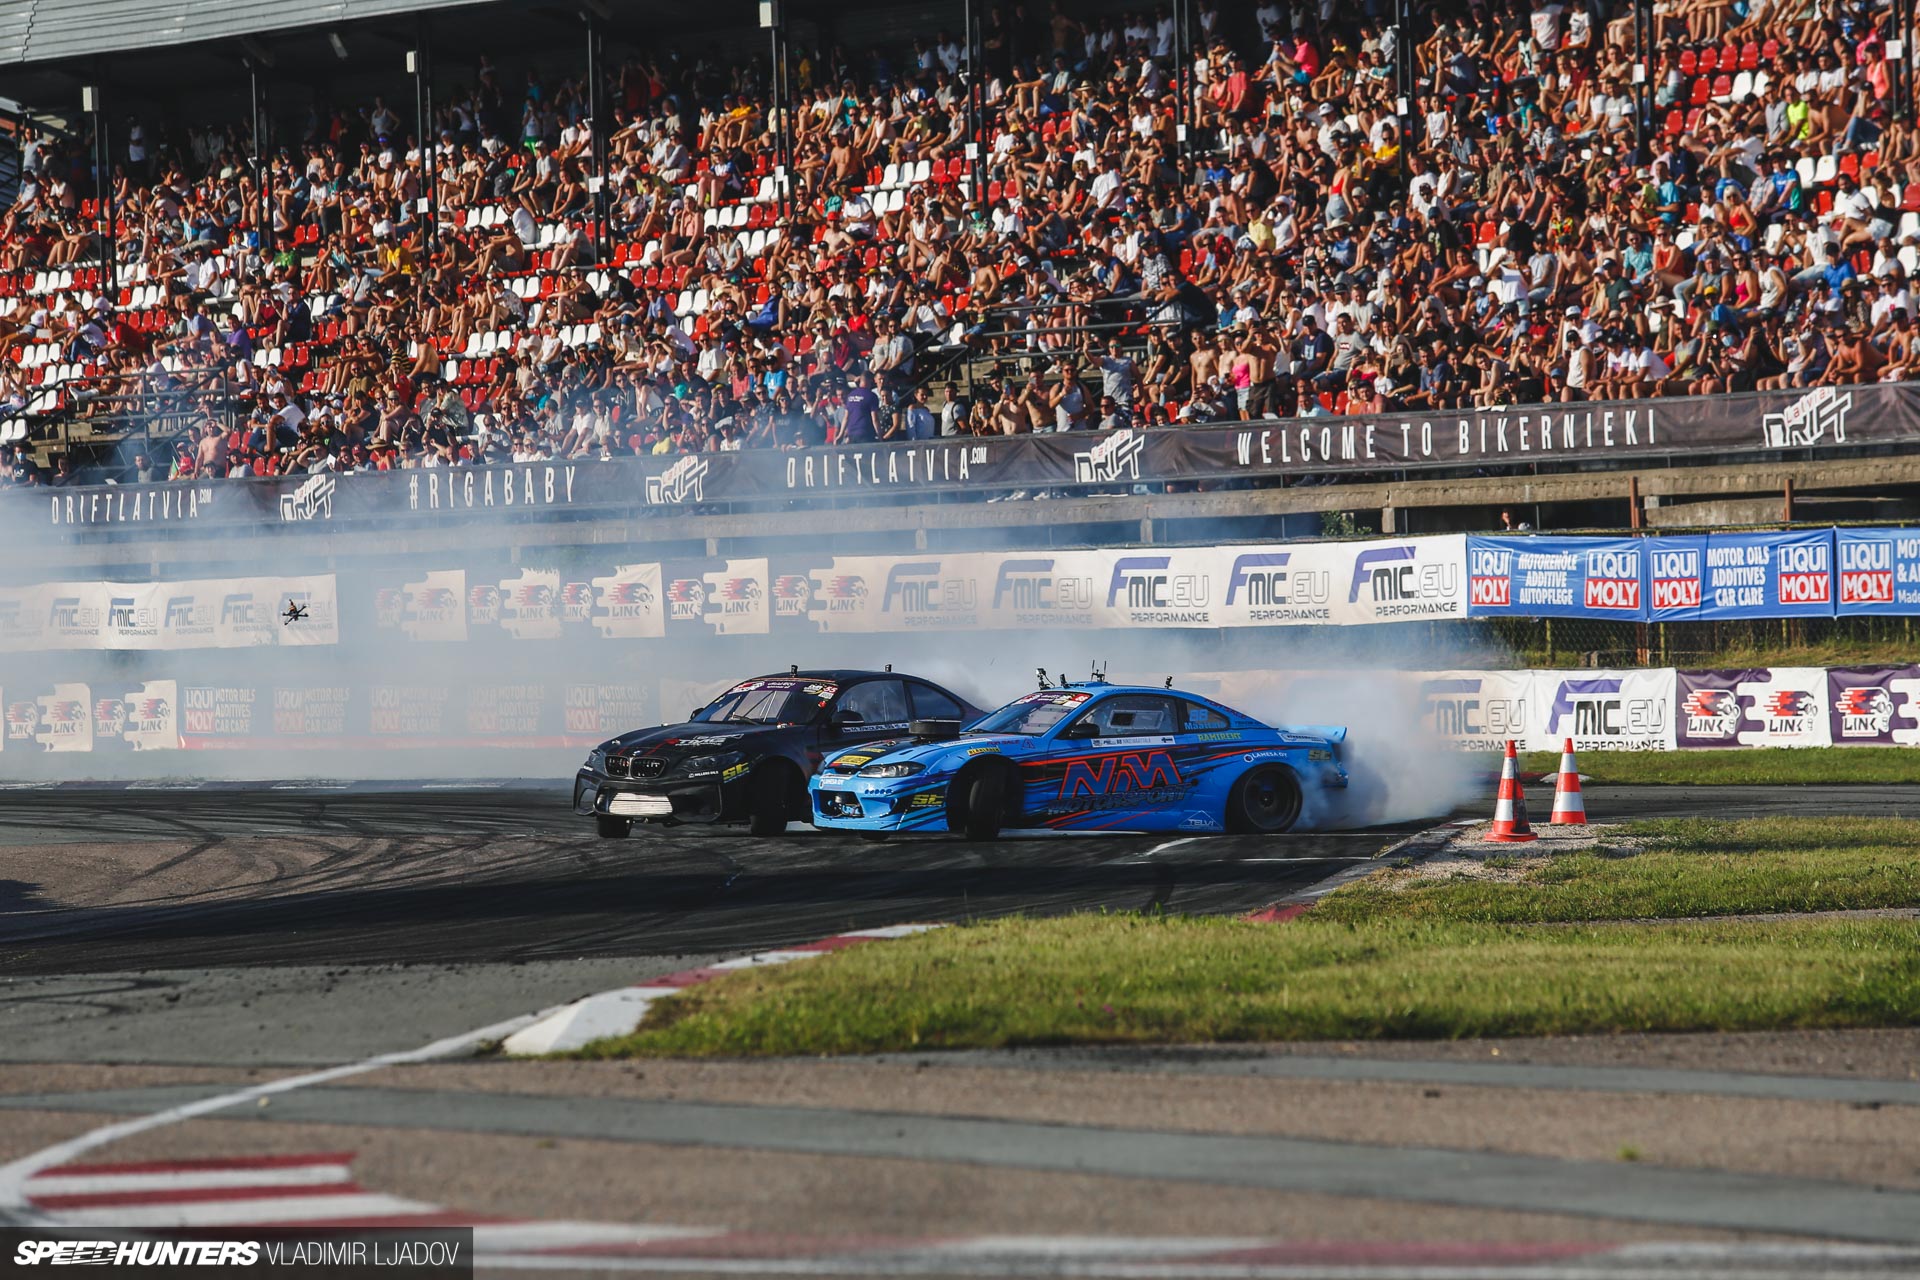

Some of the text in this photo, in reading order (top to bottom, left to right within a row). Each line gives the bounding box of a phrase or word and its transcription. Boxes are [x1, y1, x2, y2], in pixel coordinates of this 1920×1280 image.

[1237, 409, 1655, 466] WELCOME TO BIKERNIEKI
[786, 446, 988, 489] DRIFTLATVIA.COM
[409, 465, 576, 510] #RIGABABY
[52, 487, 212, 524] DRIFTLATVIA.COM
[1707, 546, 1770, 567] MOTOR OILS
[1781, 545, 1827, 573] LIQUI
[1842, 544, 1889, 572] LIQUI
[1897, 538, 1920, 559] MO
[1472, 549, 1509, 576] LIQUI
[1518, 551, 1578, 571] MOTORENÖLE
[1589, 551, 1637, 580] LIQUI
[1653, 552, 1697, 579] LIQUI
[1525, 571, 1567, 587] ADDITIVE
[1712, 567, 1766, 587] ADDITIVES
[1843, 573, 1892, 600] MOLY
[1472, 578, 1509, 604] MOLY
[1519, 588, 1573, 605] AUTOPFLEGE
[1587, 581, 1639, 608] MOLY
[1654, 580, 1699, 606] MOLY
[1715, 587, 1764, 607] CAR CARE
[1781, 575, 1829, 601] MOLY
[1016, 613, 1093, 624] PERFORMANCE
[1130, 612, 1209, 623] PERFORMANCE
[1250, 609, 1330, 621] PERFORMANCE
[1376, 602, 1457, 617] PERFORMANCE
[904, 615, 977, 626] PERFORMANCE
[186, 689, 213, 709] LIQUI
[186, 711, 214, 731] MOLY
[216, 703, 250, 718] ADDITIVES
